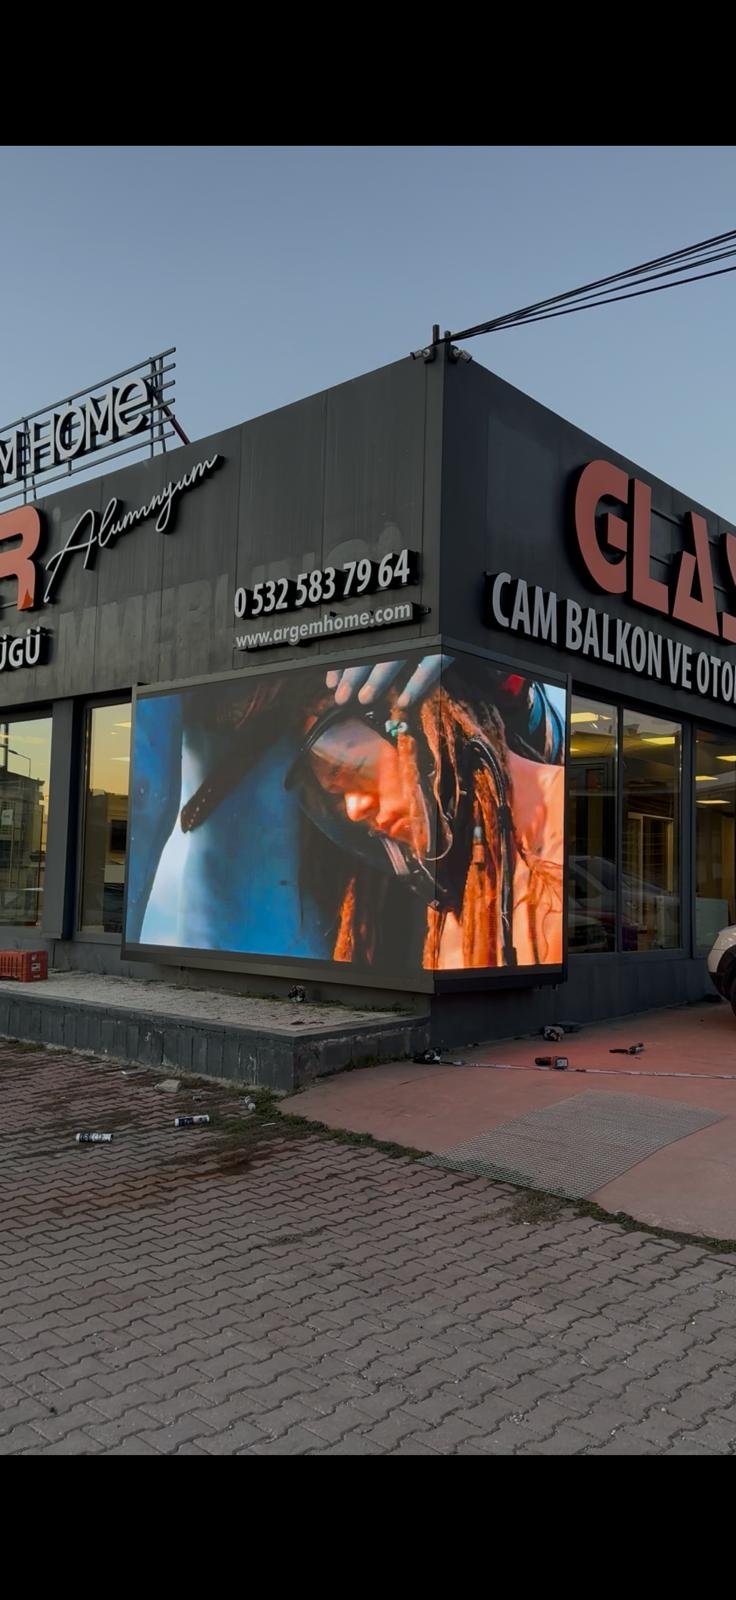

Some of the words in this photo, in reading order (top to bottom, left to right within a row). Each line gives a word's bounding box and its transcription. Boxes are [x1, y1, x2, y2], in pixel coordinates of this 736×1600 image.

[234, 587, 247, 619] 0
[251, 577, 289, 615] 532
[294, 566, 336, 607] 583
[342, 558, 372, 596] 79
[377, 549, 410, 588] 64
[235, 603, 412, 648] www.argemhome.com
[492, 571, 558, 644] CAM
[565, 598, 663, 680] BALKON
[667, 638, 693, 690] VE
